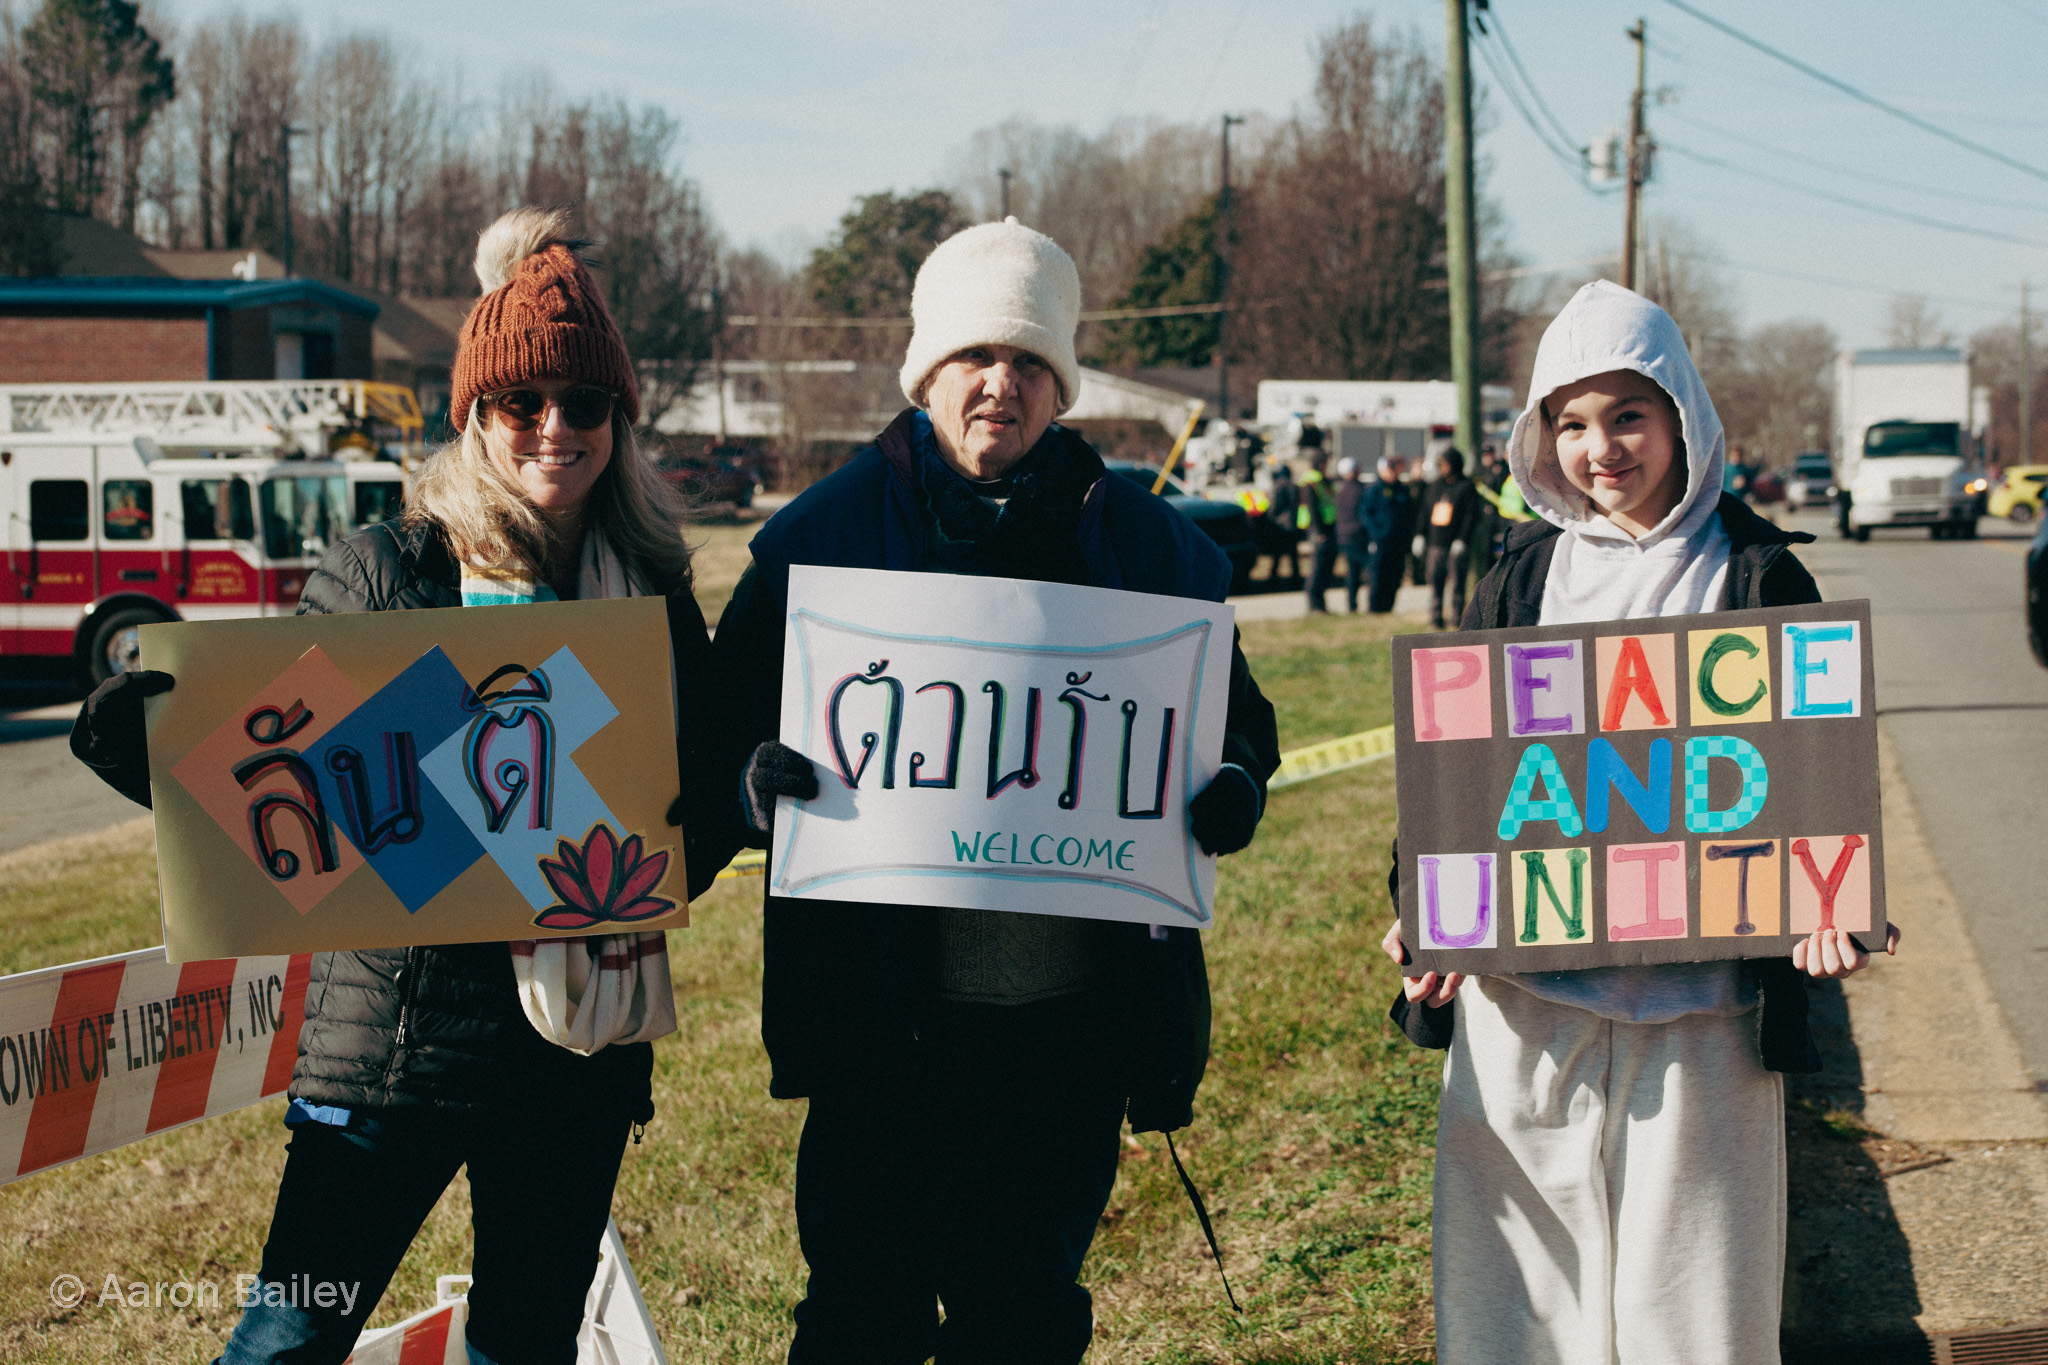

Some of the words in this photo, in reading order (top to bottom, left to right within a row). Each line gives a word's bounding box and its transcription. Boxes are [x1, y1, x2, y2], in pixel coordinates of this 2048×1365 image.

[1413, 623, 1854, 741] PEACE
[1497, 735, 1769, 841] AND
[951, 830, 1136, 872] WELCOME
[1419, 834, 1864, 948] UNITY
[77, 1013, 116, 1084] OF
[122, 985, 244, 1072] LIBERTY,
[248, 974, 285, 1038] NC
